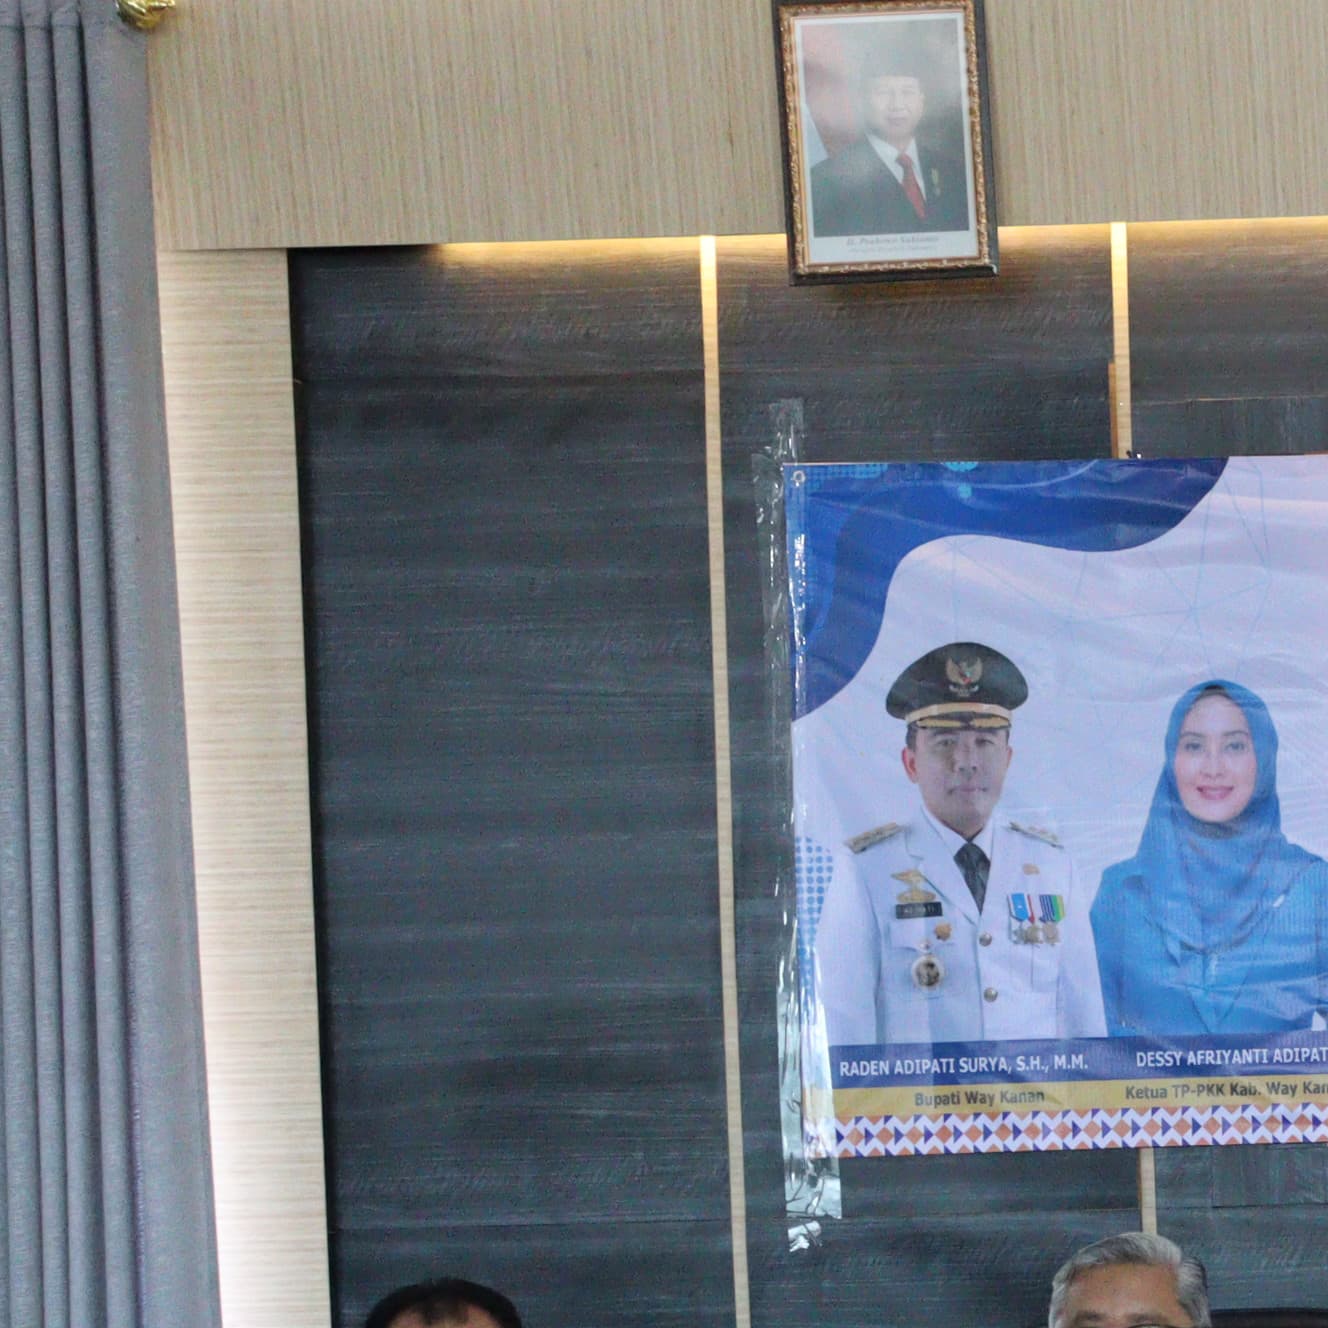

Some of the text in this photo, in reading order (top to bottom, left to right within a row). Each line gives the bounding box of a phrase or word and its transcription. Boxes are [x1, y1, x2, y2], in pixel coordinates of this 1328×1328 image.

[840, 1053, 1089, 1077] RADEN ADIPATI SURYA, S.H., M.M.
[1136, 1051, 1183, 1067] DESSY
[1187, 1048, 1268, 1066] AFRIYANTI
[914, 1090, 1045, 1108] Bupati Way Kanan
[1125, 1084, 1168, 1100] Ketua
[1172, 1083, 1226, 1098] TP-PKK
[1230, 1082, 1262, 1097] Kab.
[1266, 1081, 1298, 1097] Way
